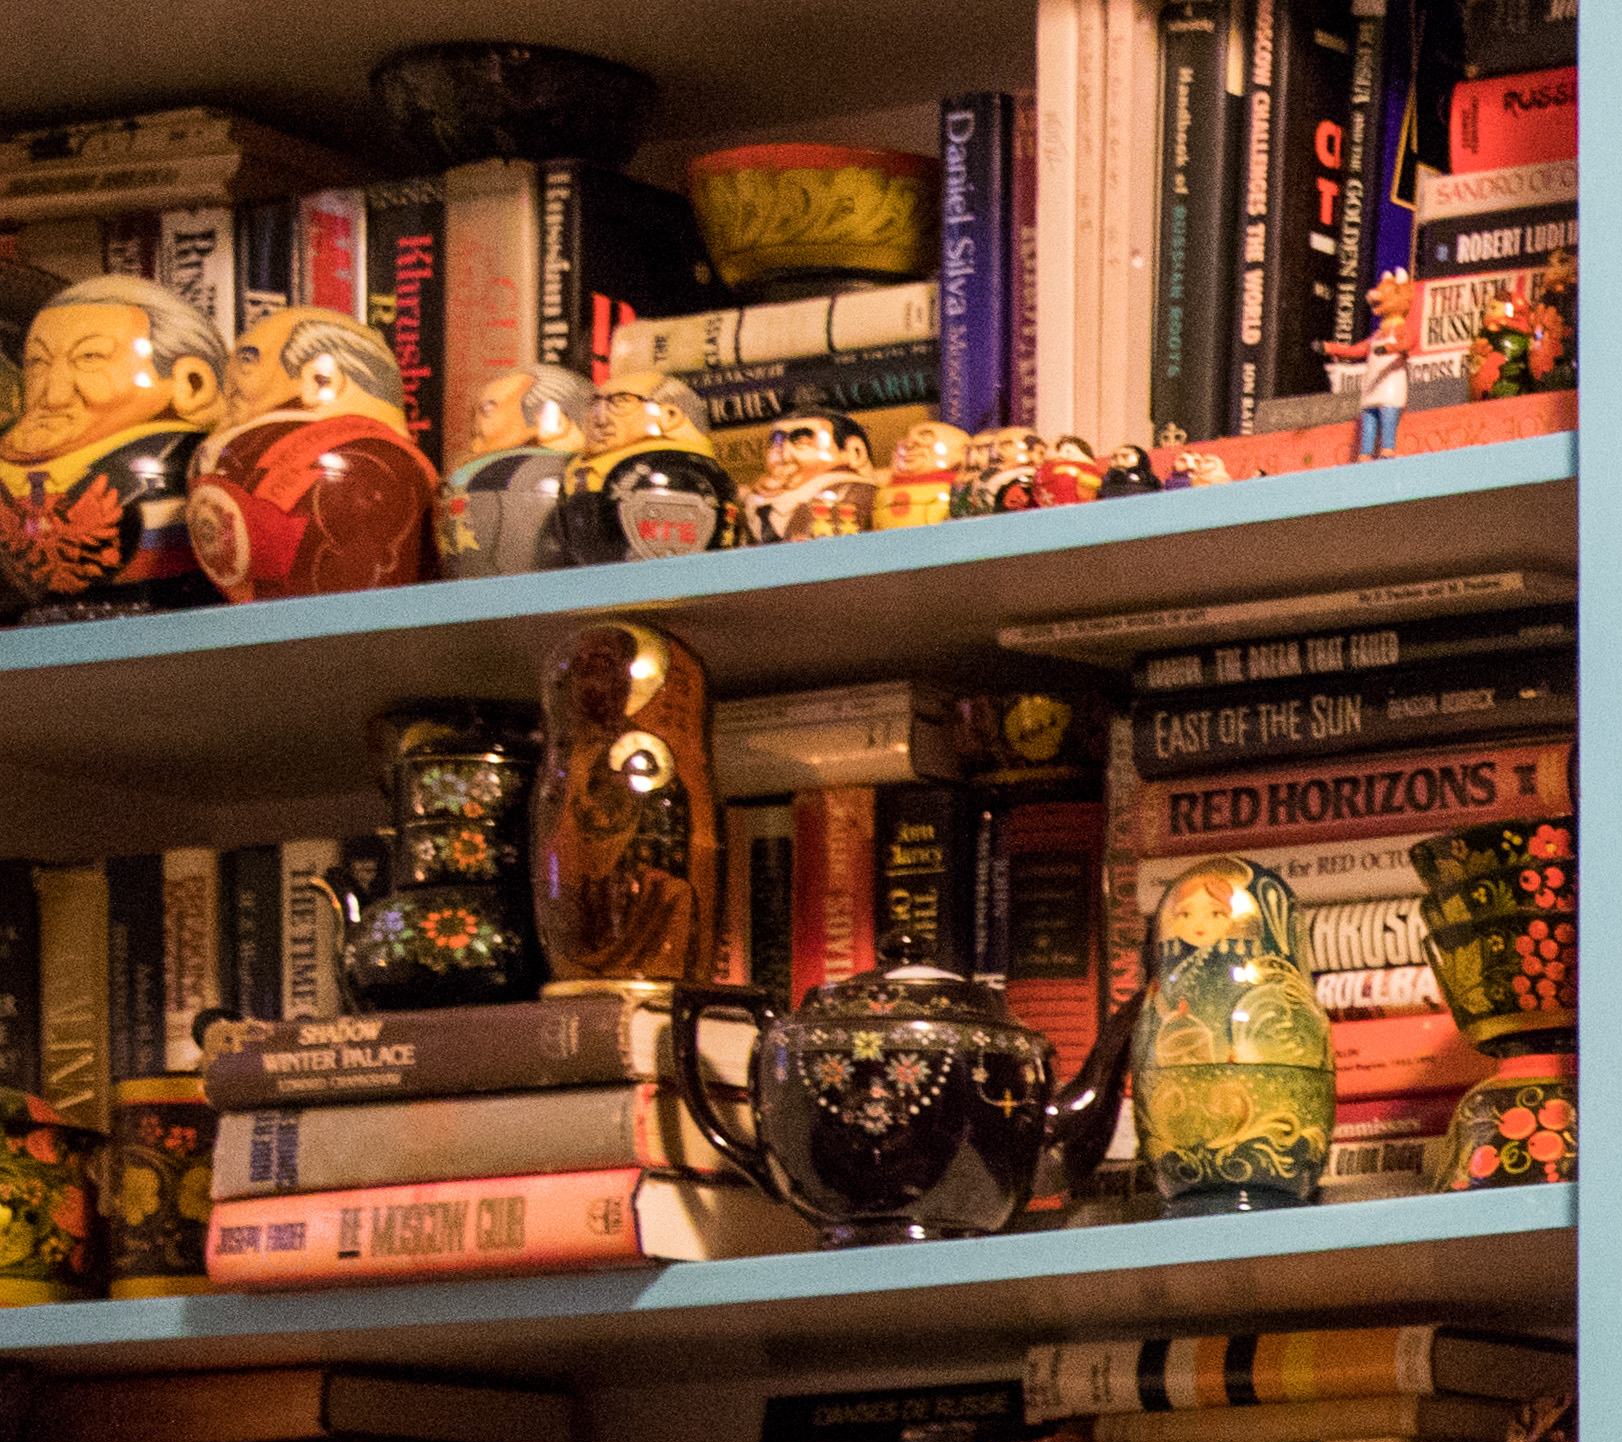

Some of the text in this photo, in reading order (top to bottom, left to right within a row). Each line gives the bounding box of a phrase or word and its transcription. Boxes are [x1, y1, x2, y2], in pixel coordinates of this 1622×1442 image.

[939, 110, 976, 317] Daniel Silva
[1154, 693, 1362, 759] EAST OF THE SUN
[1170, 762, 1497, 837] RED HORIZONS
